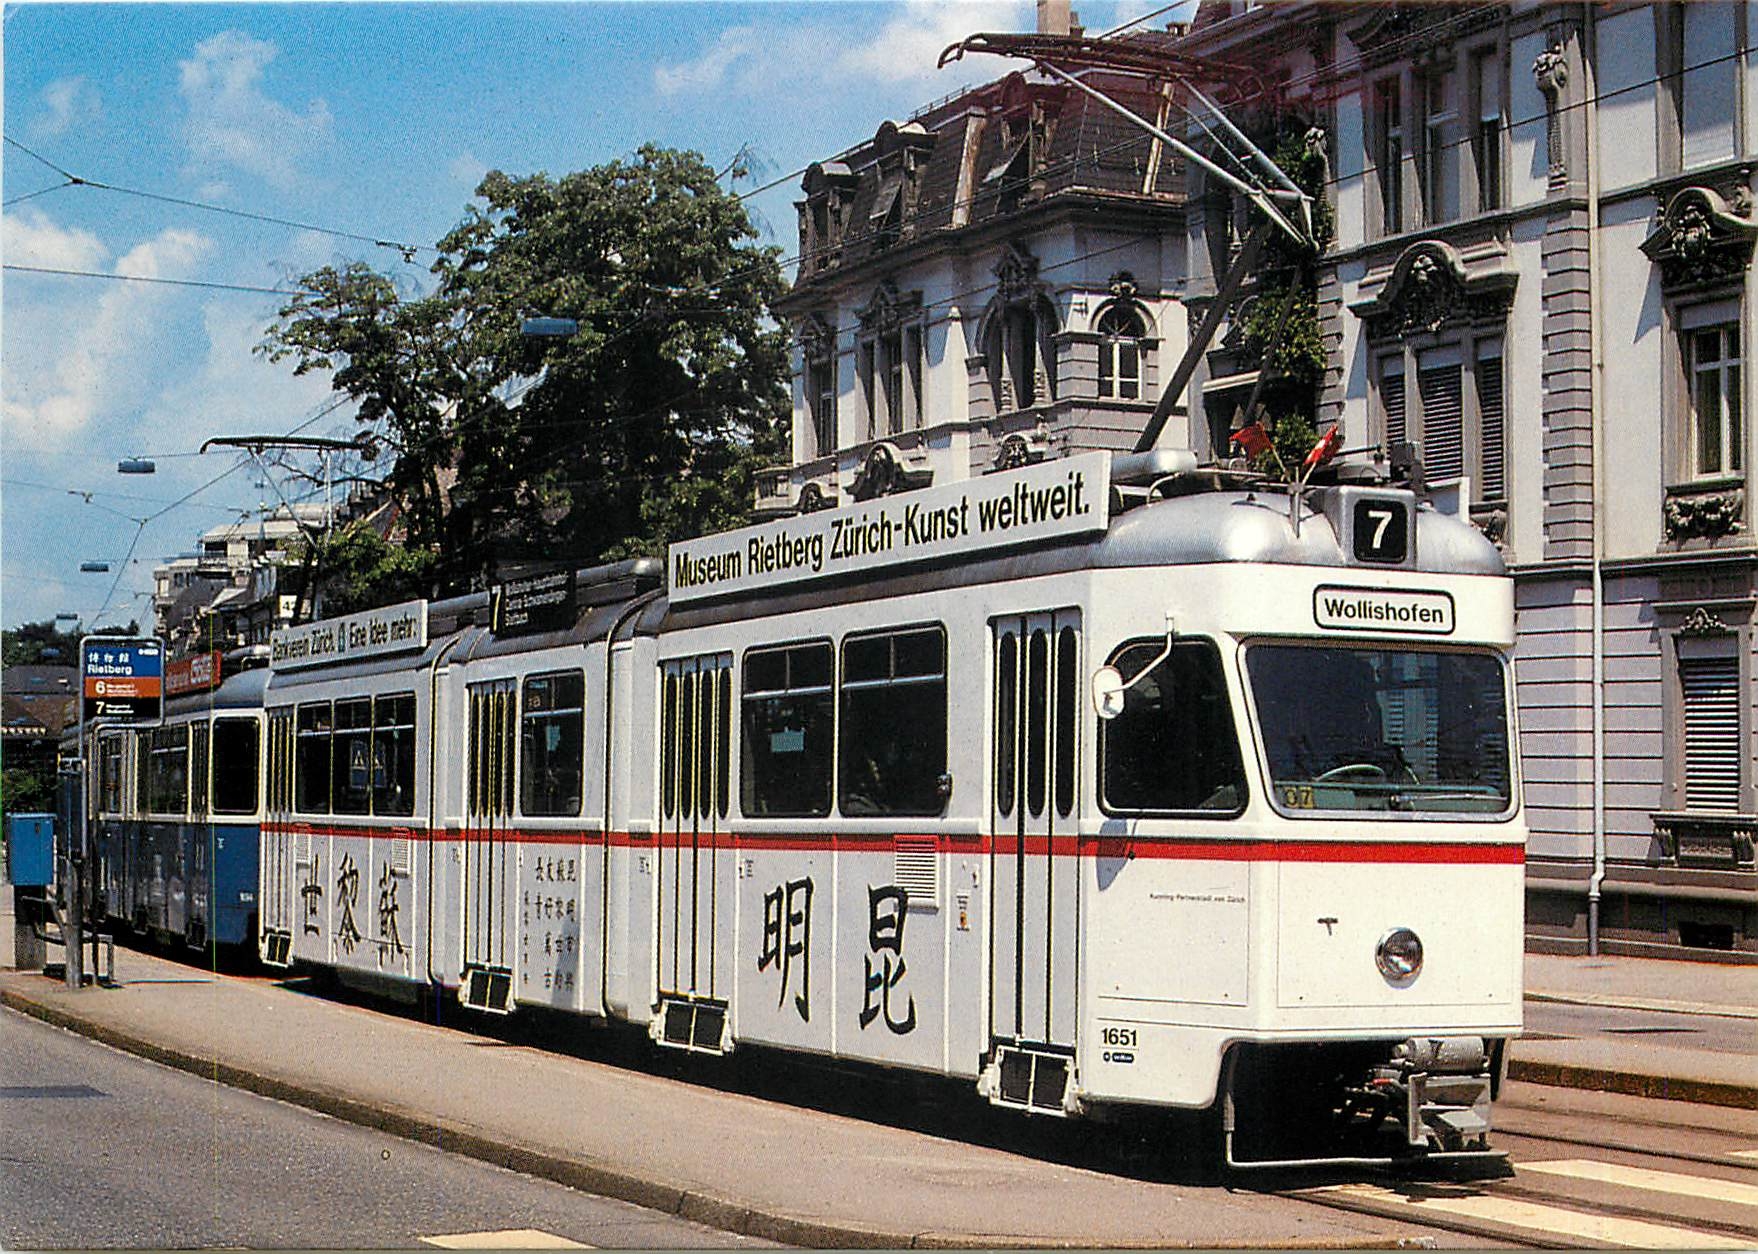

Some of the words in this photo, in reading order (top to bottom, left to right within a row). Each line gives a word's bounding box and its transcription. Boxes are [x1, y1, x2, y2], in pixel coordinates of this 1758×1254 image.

[675, 551, 742, 588] Museum
[748, 530, 824, 573] Rietberg
[830, 495, 969, 560] Zürich-Kunst
[979, 471, 1090, 533] weltweit.
[1368, 510, 1393, 549] 7
[491, 585, 501, 632] 7
[1323, 598, 1444, 623] Wollishofen
[87, 664, 133, 675] Rietberg
[95, 681, 106, 695] 6
[96, 702, 105, 714] 7
[1101, 1027, 1137, 1047] 1651
